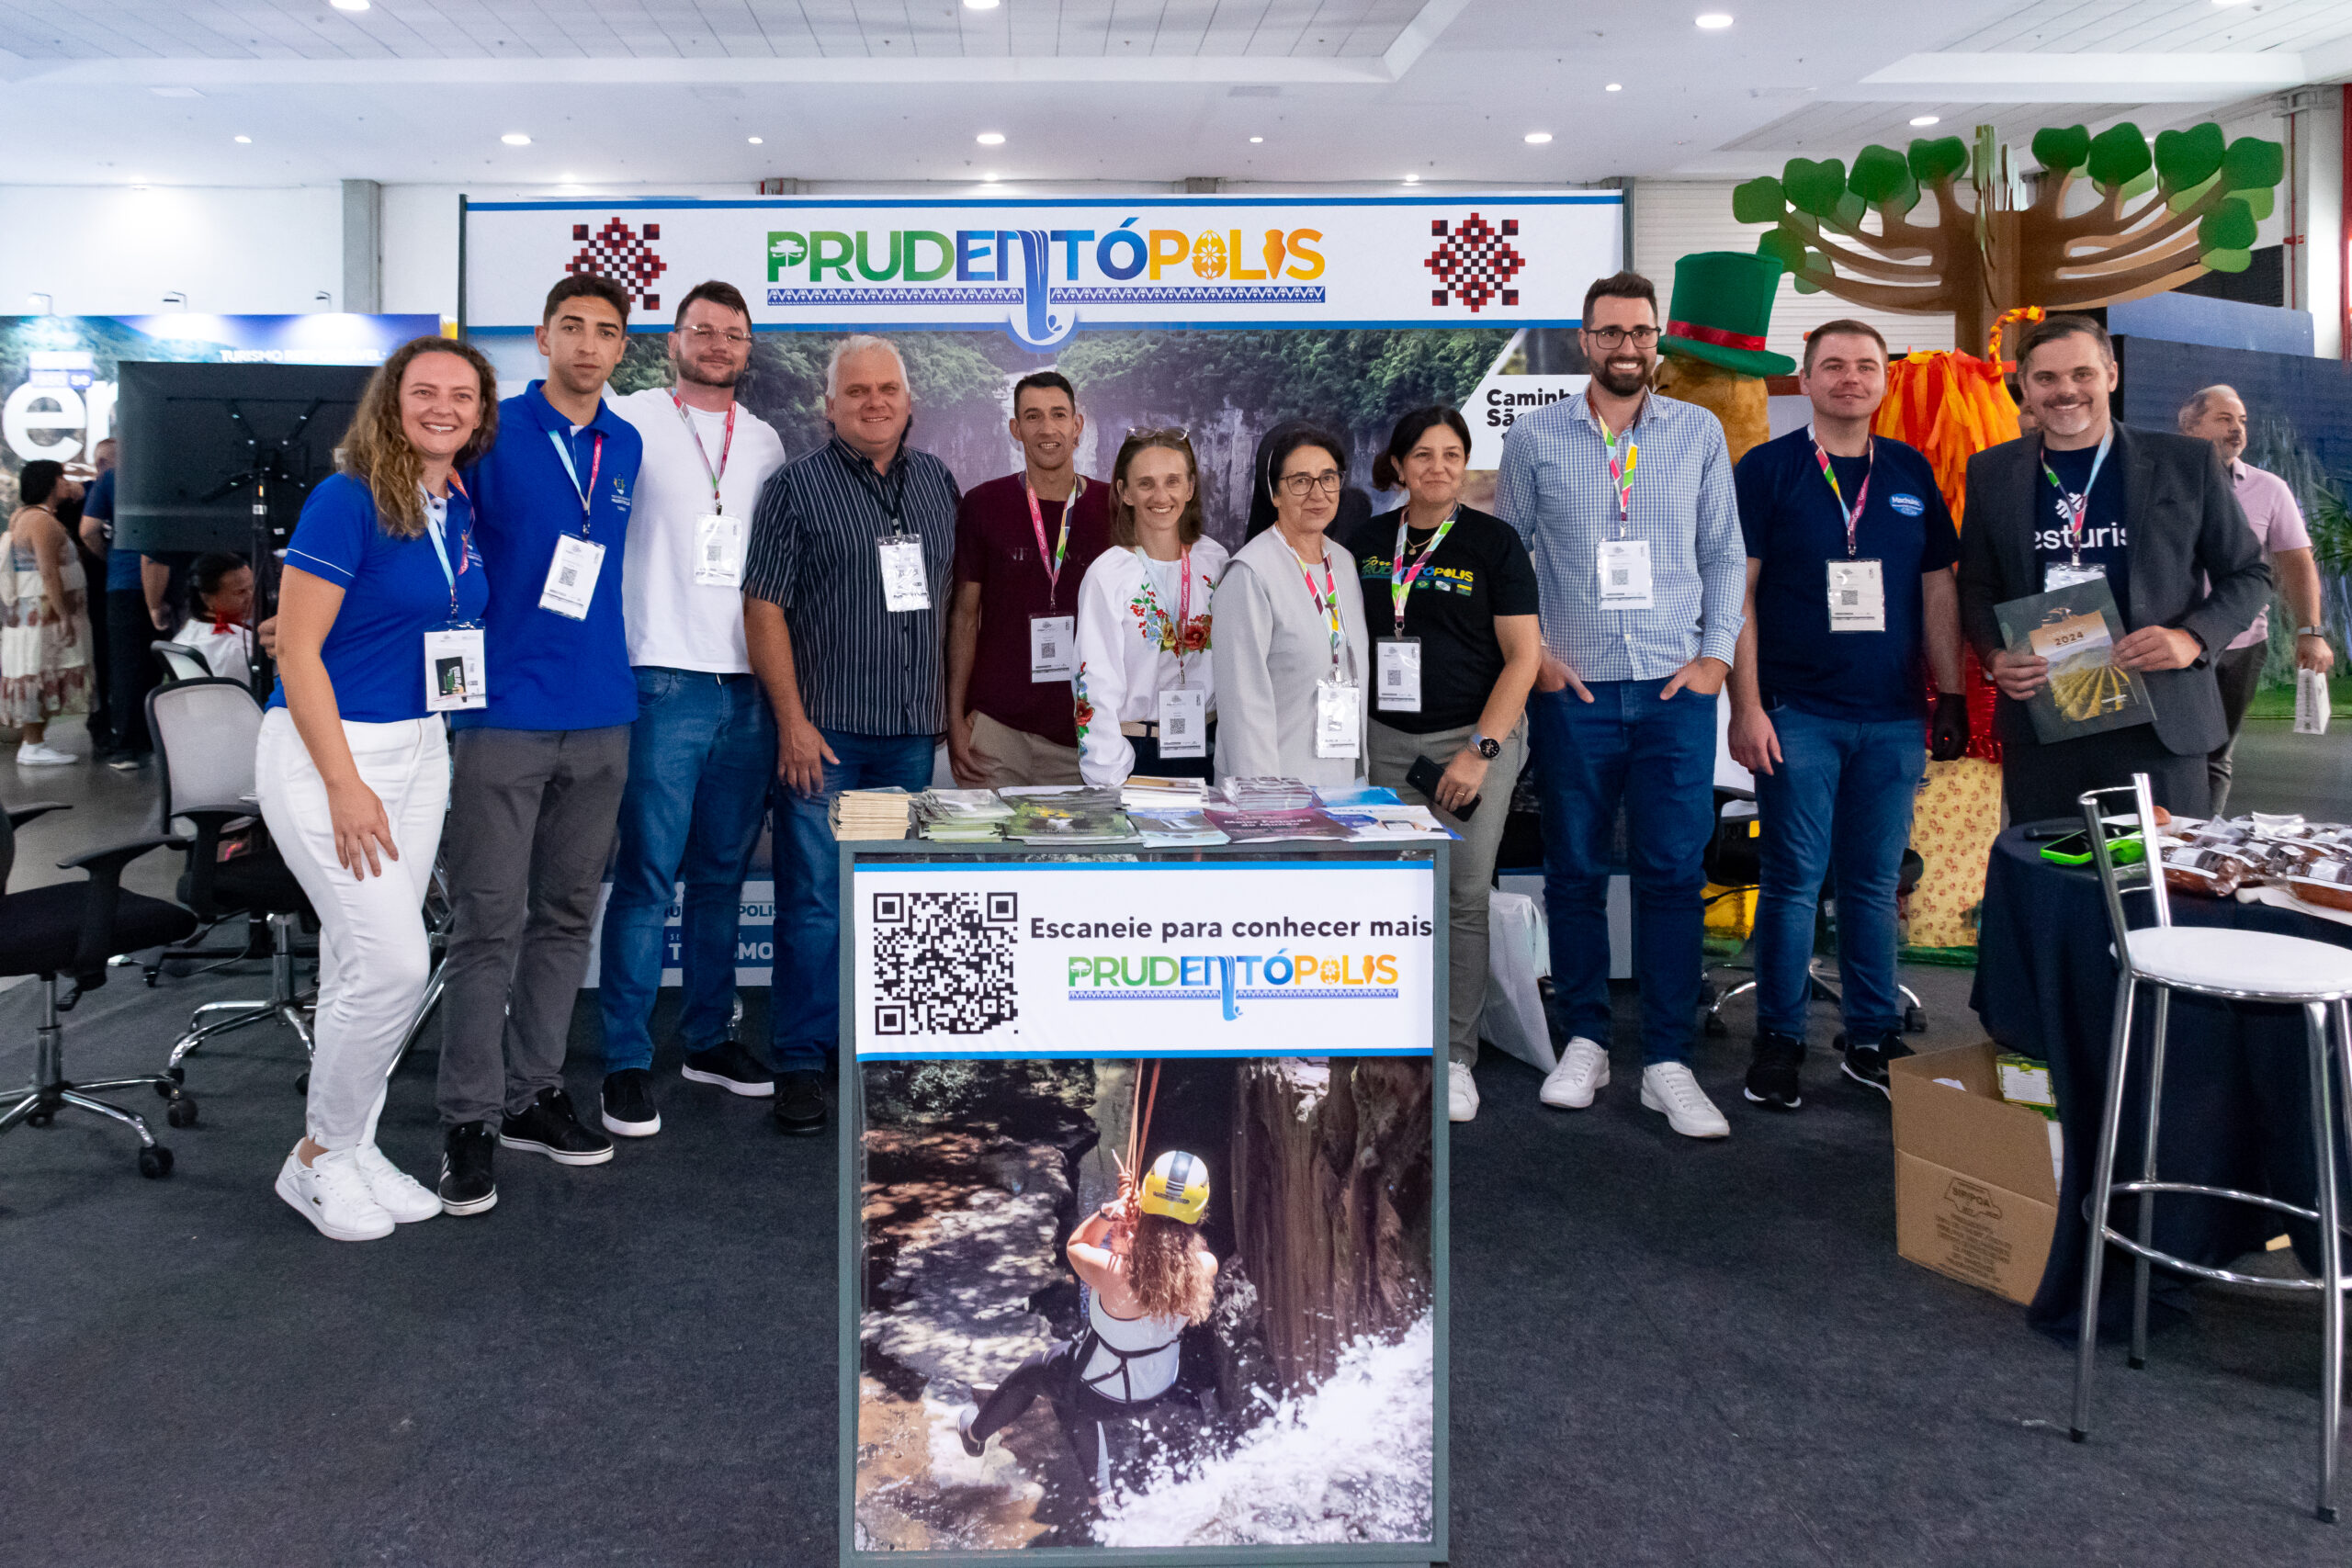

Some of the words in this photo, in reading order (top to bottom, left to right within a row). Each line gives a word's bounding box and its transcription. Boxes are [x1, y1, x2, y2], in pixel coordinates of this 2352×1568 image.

[766, 217, 1327, 282] PRUDENTÓPOLIS
[1486, 388, 1572, 406] Caminh
[1486, 408, 1525, 427] Sã
[2055, 631, 2085, 646] 2024
[1030, 917, 1153, 939] Escaneie
[1161, 921, 1223, 943] para
[1231, 916, 1361, 938] conhecer
[1370, 914, 1433, 938] mais
[1069, 948, 1399, 987] PRUDENTÓPOLIS
